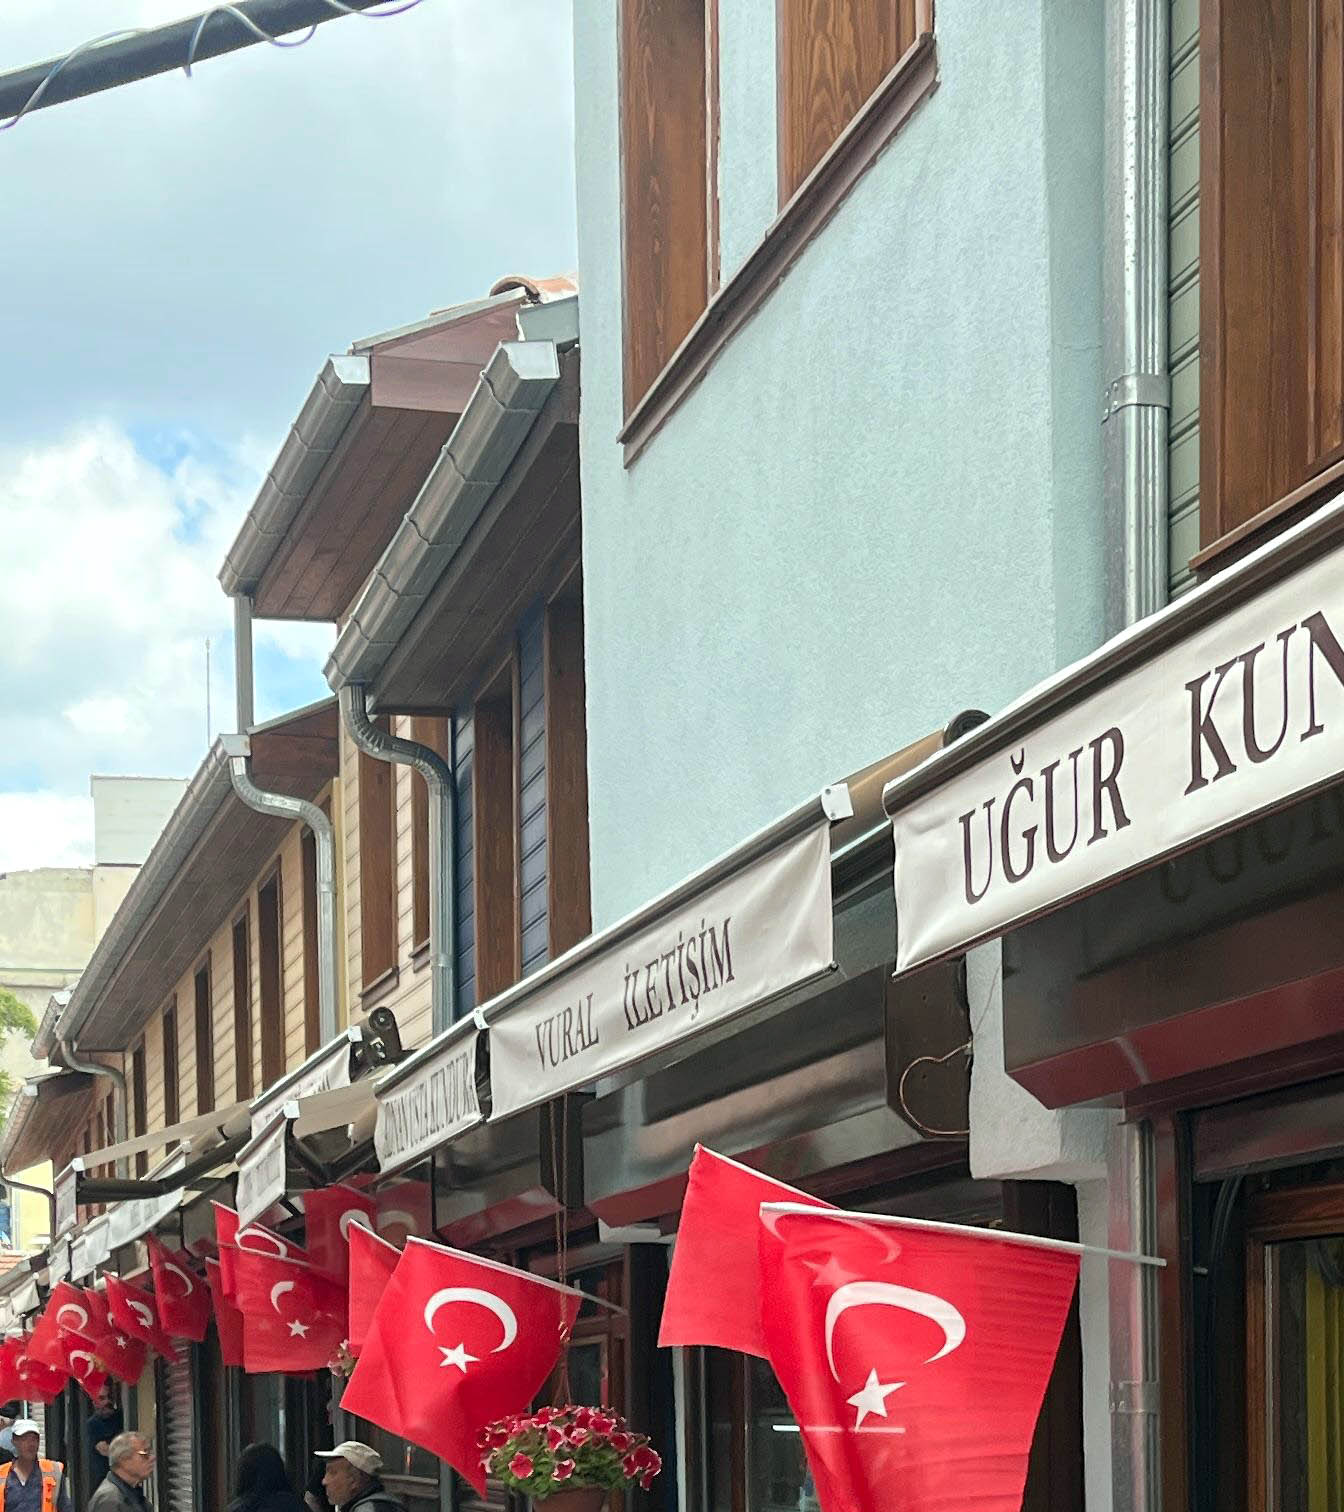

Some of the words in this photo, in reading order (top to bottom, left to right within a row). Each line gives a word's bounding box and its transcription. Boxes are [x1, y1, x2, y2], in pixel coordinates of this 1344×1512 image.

[958, 725, 1132, 906] UĞUR
[535, 992, 599, 1072] VURAL
[622, 916, 736, 1031] İLETİŞİM
